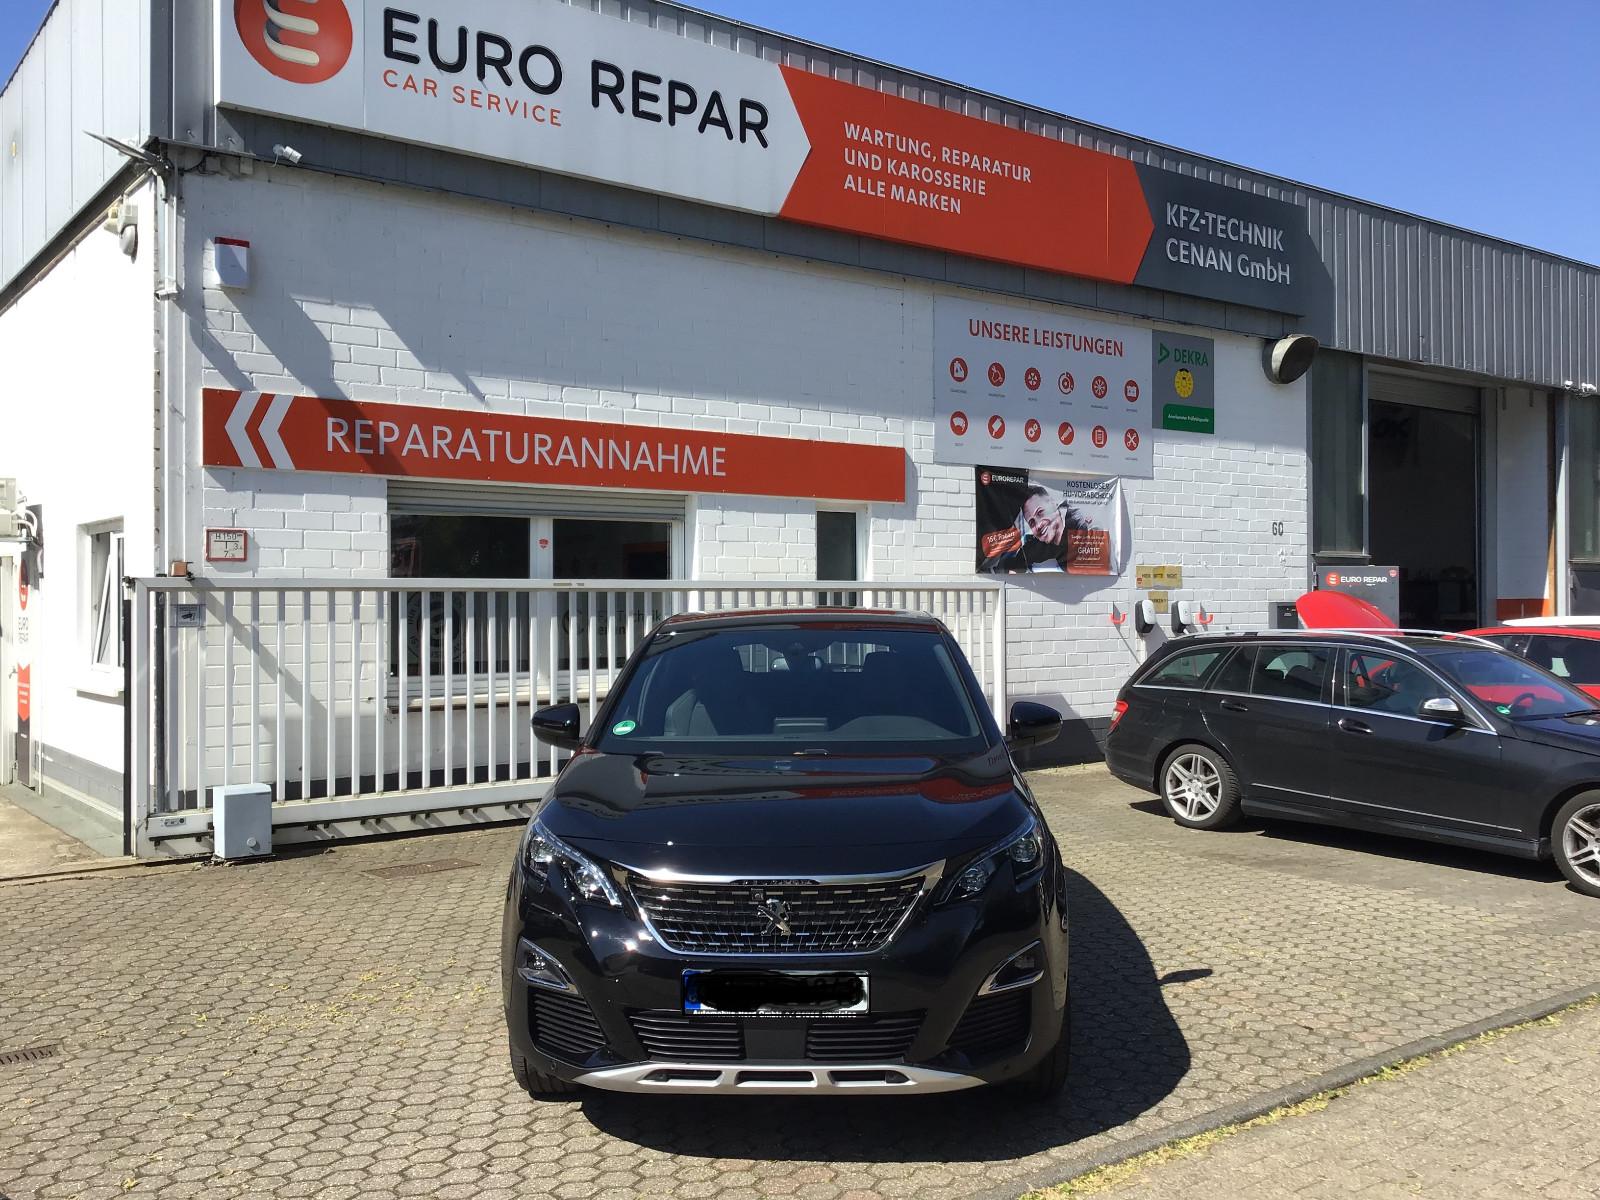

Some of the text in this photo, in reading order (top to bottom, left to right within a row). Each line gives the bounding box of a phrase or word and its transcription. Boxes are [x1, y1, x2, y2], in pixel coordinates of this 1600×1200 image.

[383, 7, 769, 149] EURO REPAR
[383, 69, 562, 127] CAR SERVICE
[843, 121, 1032, 184] WARTUNG, REPARATUR
[843, 147, 987, 197] UND KAROSSERIE
[843, 174, 962, 215] ALLE MARKEN
[1166, 202, 1284, 252] KFZ-TECHNIK
[1166, 237, 1291, 286] CENAN GmbH
[968, 318, 1123, 357] UNSERE LEISTUNGEN
[1174, 348, 1209, 367] DEKRA
[326, 416, 726, 477] REPARATURANNAHME
